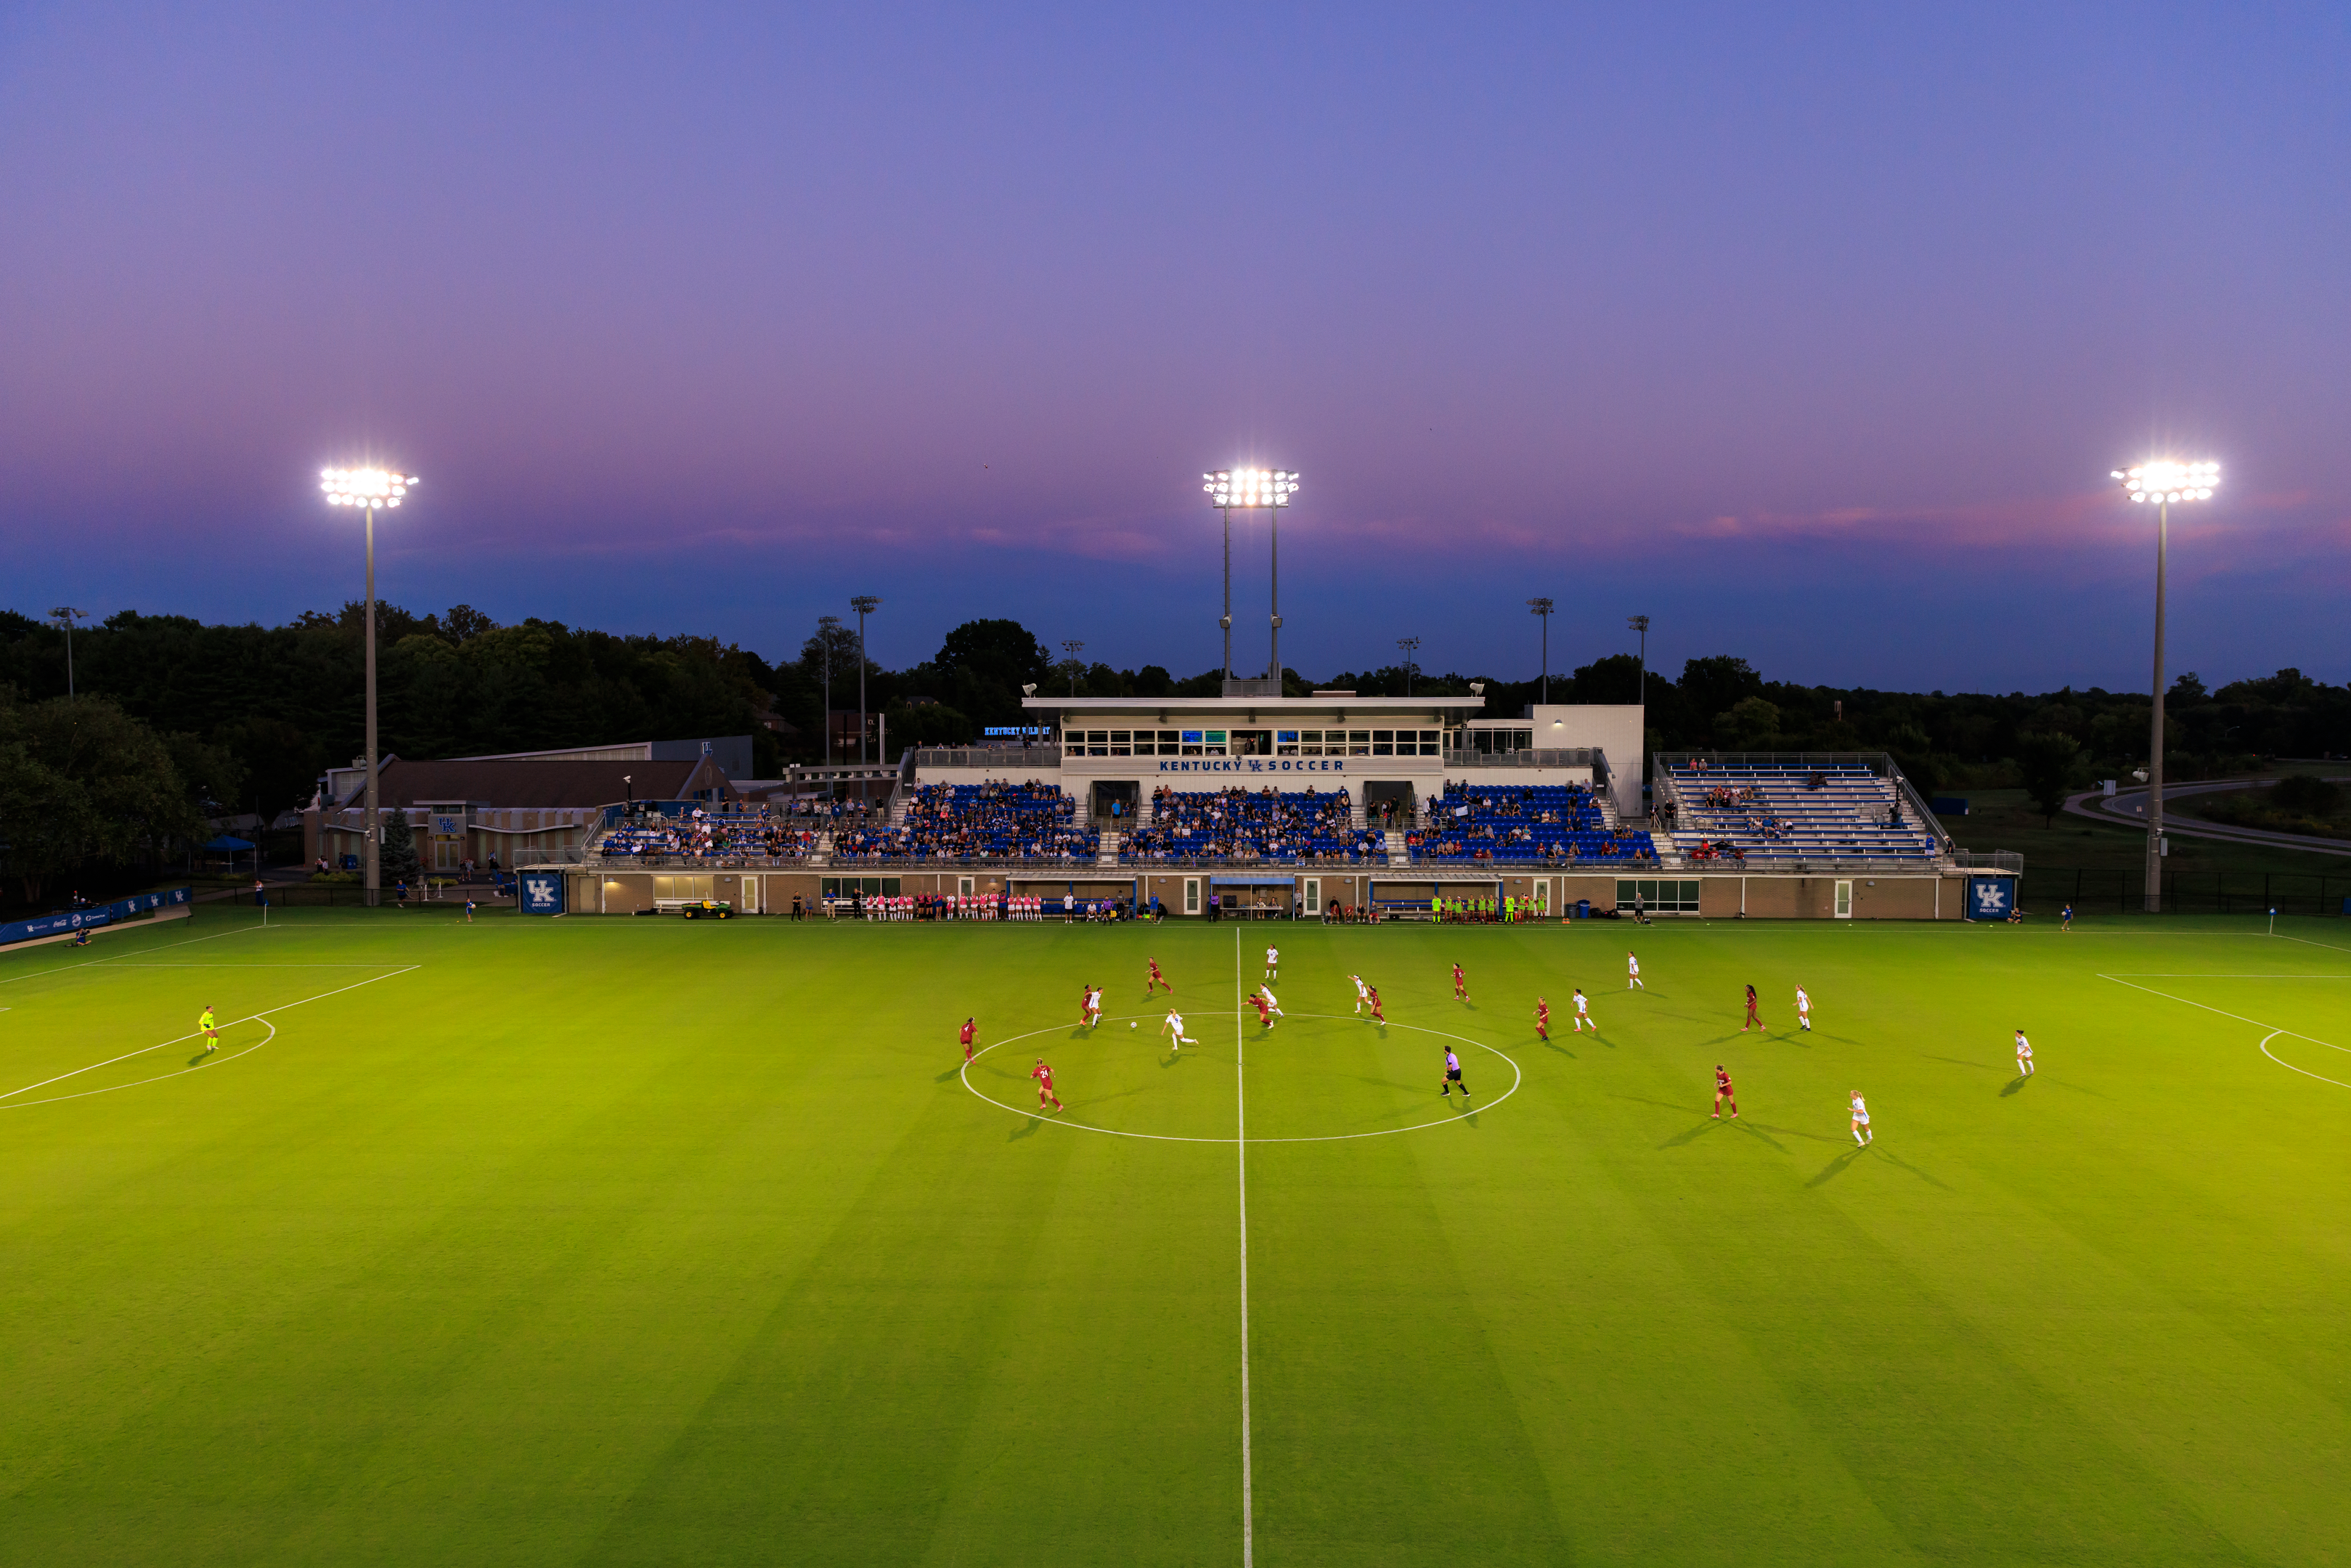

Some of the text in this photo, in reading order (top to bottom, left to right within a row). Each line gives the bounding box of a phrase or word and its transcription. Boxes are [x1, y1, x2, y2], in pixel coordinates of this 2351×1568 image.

[985, 727, 1020, 735] KENTUCKY
[1160, 759, 1343, 772] KENTUCKY UK SOCCER
[438, 817, 456, 833] UK
[175, 890, 184, 902] UK
[526, 880, 555, 902] UK
[1976, 883, 2005, 907] UK
[128, 900, 136, 912] UK
[150, 895, 158, 907] UK
[1040, 1069, 1048, 1079] 24
